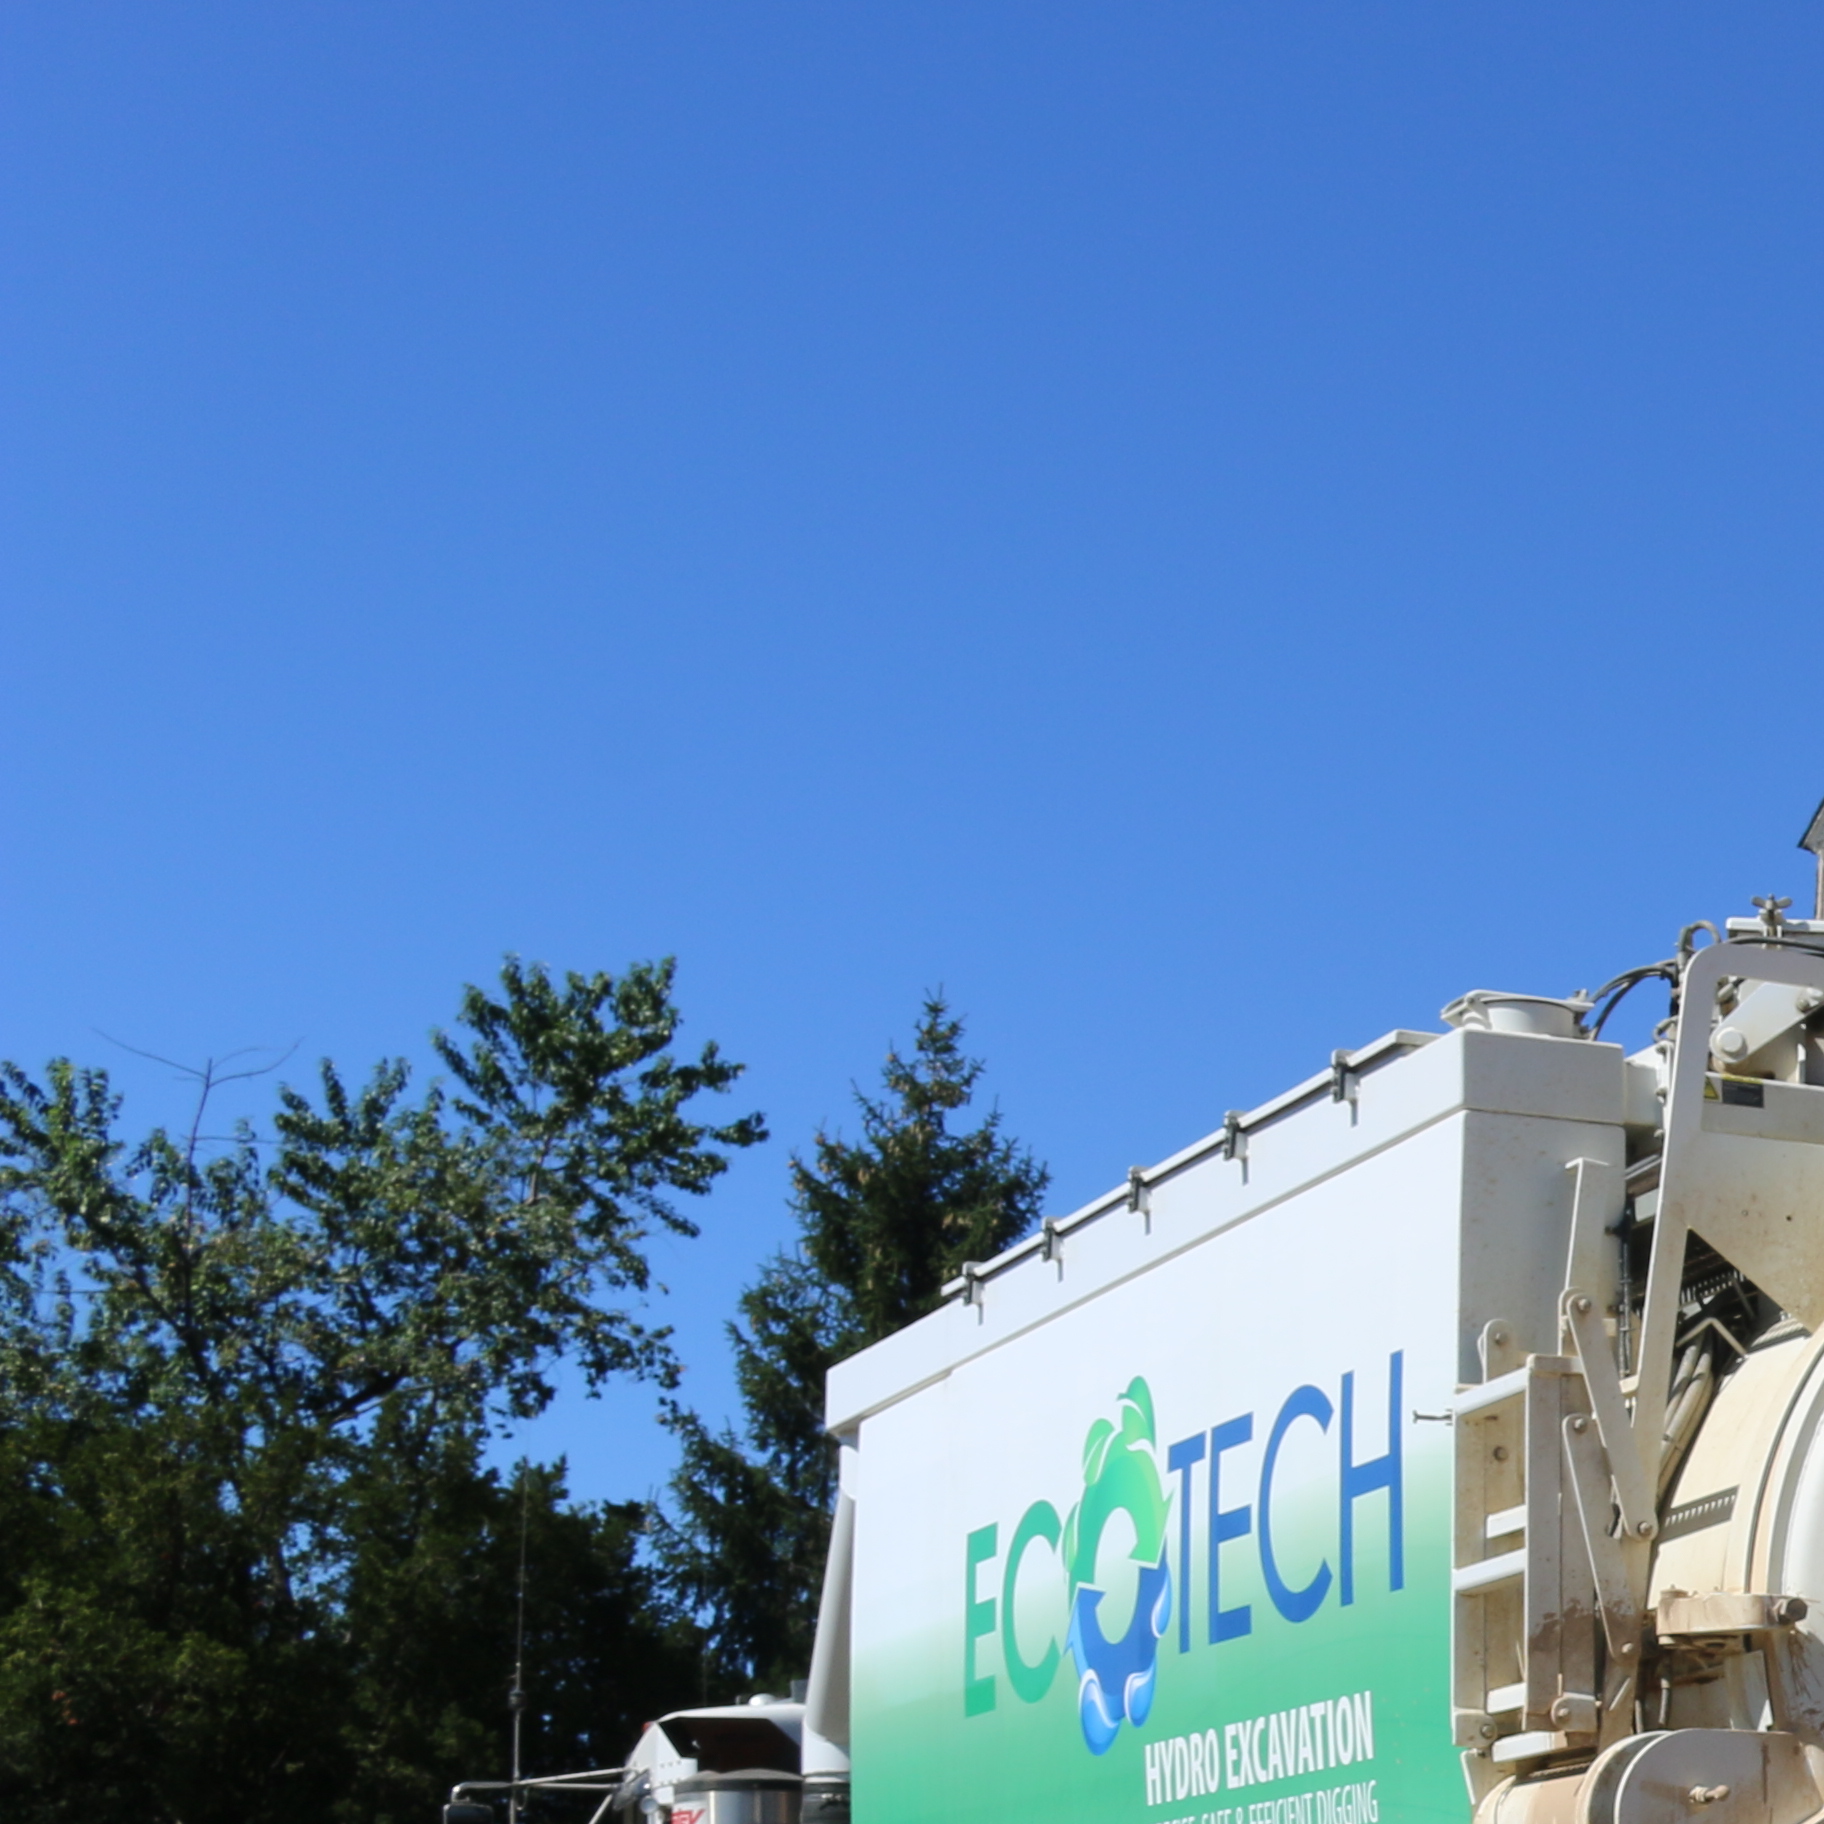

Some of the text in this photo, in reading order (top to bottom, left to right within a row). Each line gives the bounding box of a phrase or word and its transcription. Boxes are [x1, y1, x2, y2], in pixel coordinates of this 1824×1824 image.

[963, 1349, 1405, 1756] ECOTECH
[1144, 1690, 1375, 1806] HYDRO EXCAVATION
